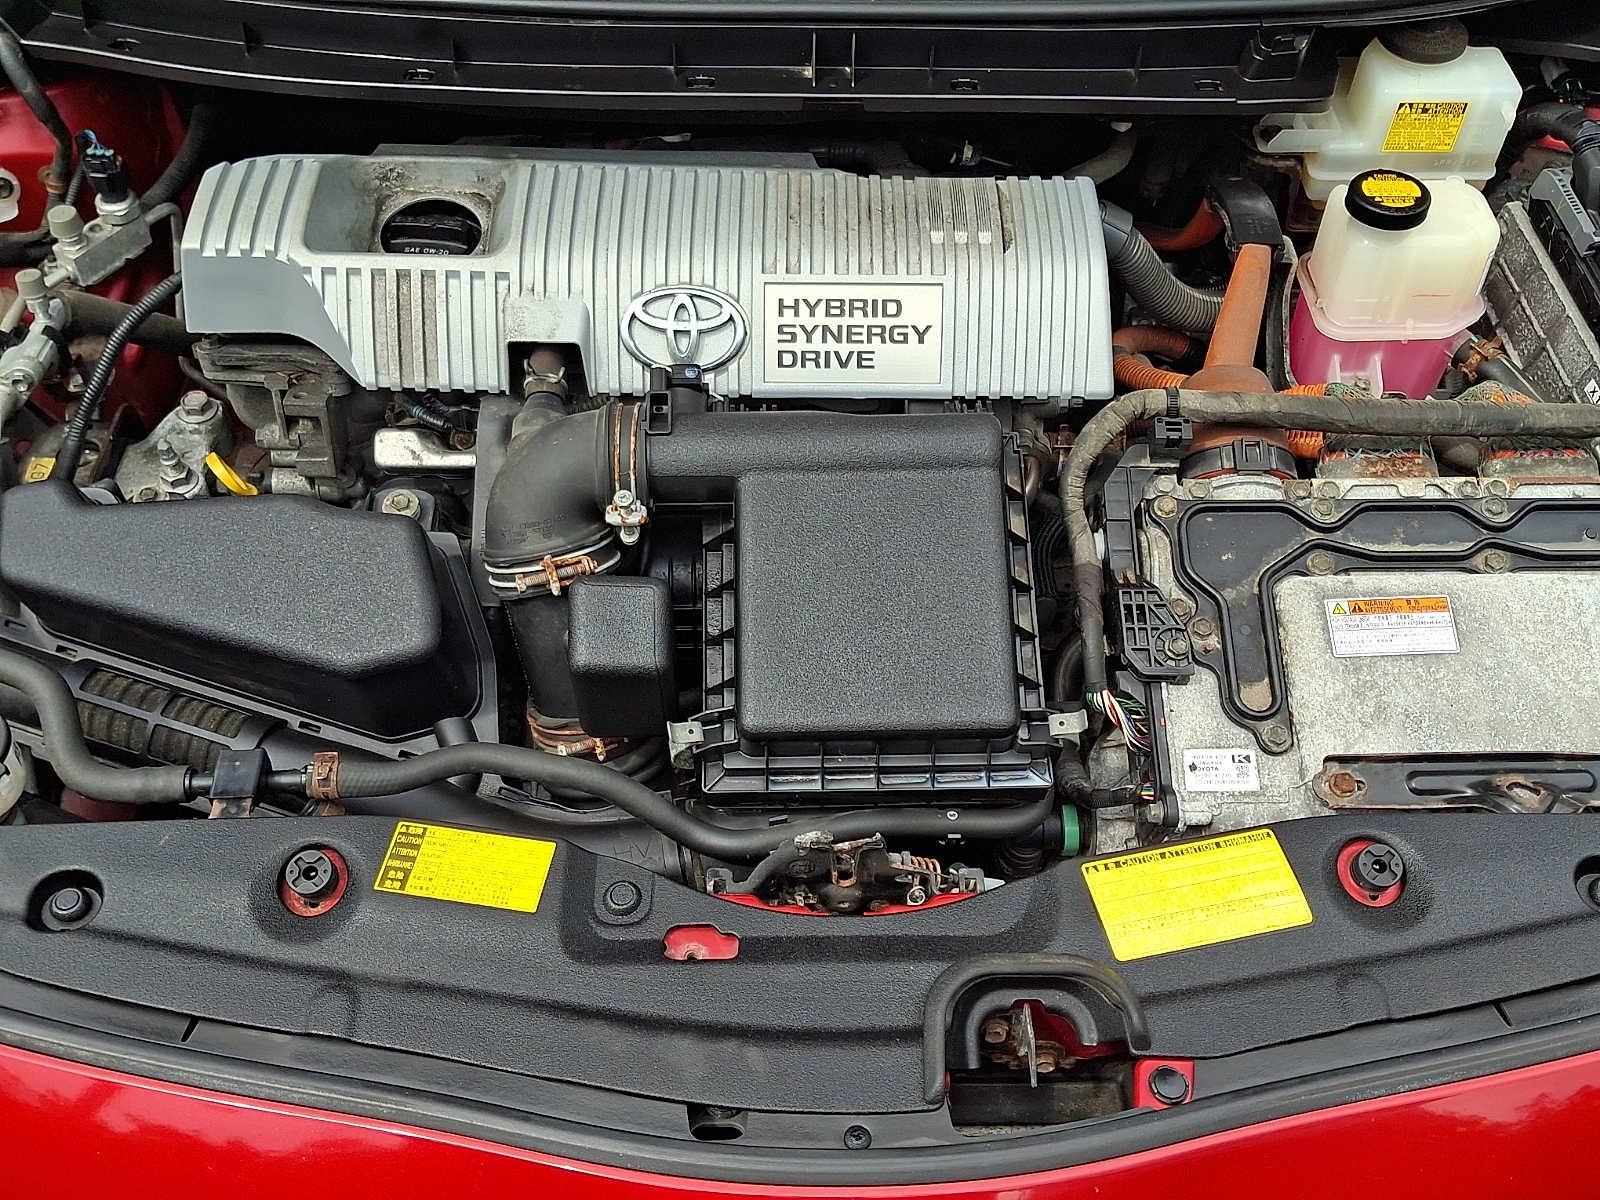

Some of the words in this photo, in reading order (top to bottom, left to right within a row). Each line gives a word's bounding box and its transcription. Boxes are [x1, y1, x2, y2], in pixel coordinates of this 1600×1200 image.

[423, 247, 449, 255] 0W-20
[778, 298, 903, 318] HYBRID
[777, 324, 933, 345] SYNERGY
[777, 350, 876, 369] DRIVE
[396, 834, 424, 845] CAUTION
[1120, 852, 1160, 868] CAUTION
[1167, 842, 1216, 858] ATTENTION
